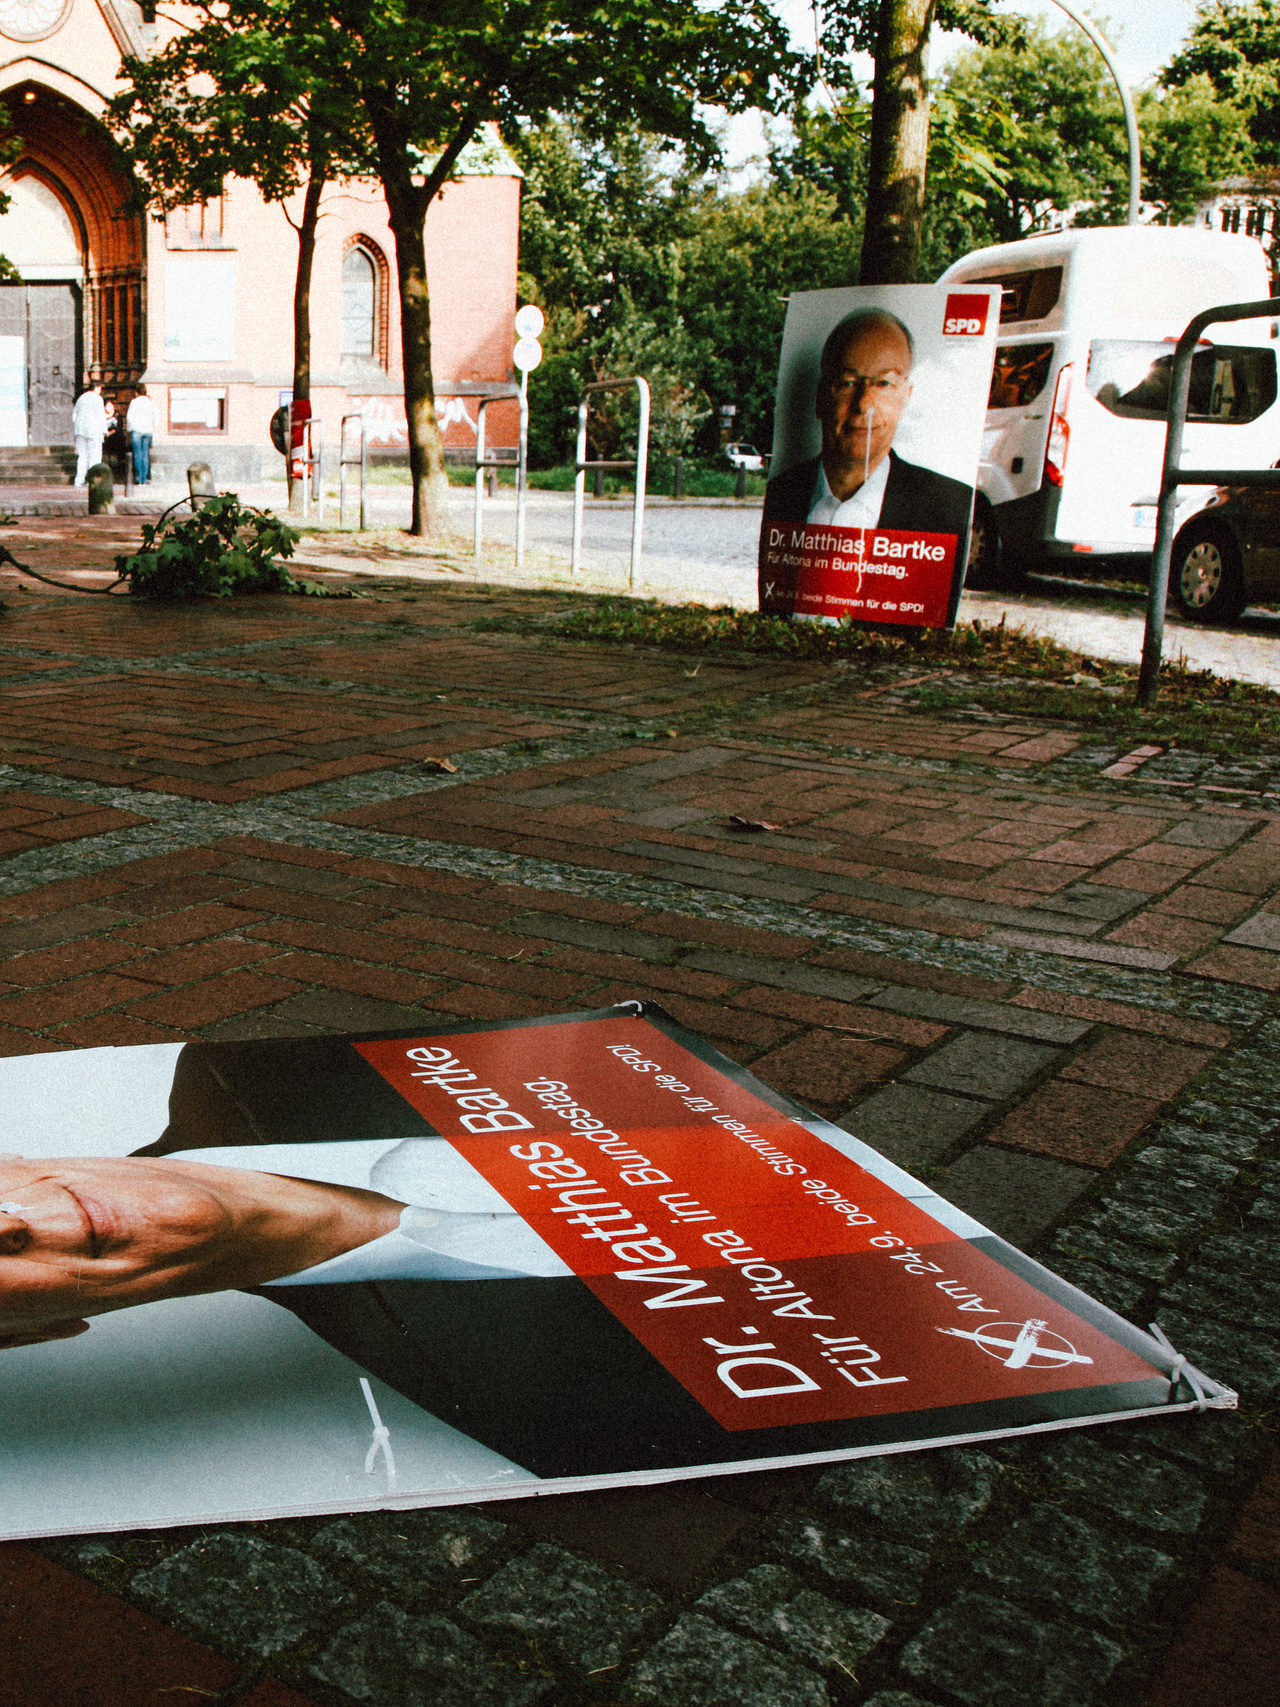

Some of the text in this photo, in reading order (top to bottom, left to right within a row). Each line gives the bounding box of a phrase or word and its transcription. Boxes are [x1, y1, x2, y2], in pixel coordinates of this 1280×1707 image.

[945, 318, 981, 333] SPD
[769, 528, 946, 562] Dr. Matthias Bartke
[767, 551, 909, 579] Für Altona im Bundestag.
[825, 594, 864, 607] Stimmen
[866, 599, 880, 610] für
[882, 600, 897, 611] die
[899, 602, 925, 613] SPD!
[605, 1044, 1001, 1313] Am 24.9. beide Stimmen für die SPD!
[406, 1046, 822, 1399] Dr. Matthias Bartke
[523, 1076, 909, 1387] Für Altona im Bundestag.
